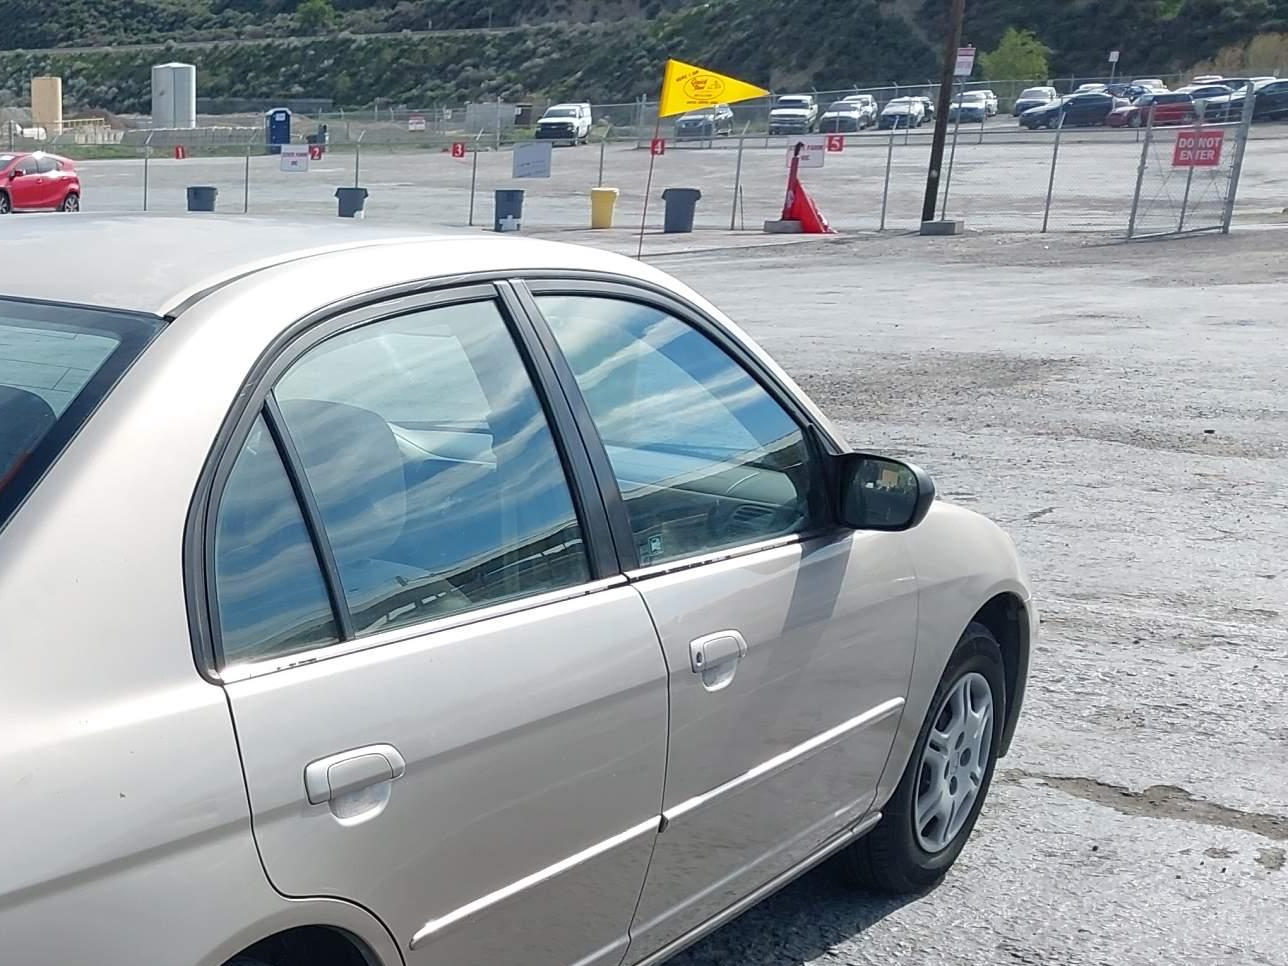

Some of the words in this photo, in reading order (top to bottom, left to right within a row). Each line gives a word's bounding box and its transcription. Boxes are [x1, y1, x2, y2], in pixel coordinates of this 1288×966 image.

[654, 140, 663, 154] 4
[830, 136, 841, 150] 5
[1178, 137, 1194, 148] DO
[1198, 136, 1221, 148] NOT
[312, 147, 320, 160] 2
[1180, 150, 1215, 161] ENTER
